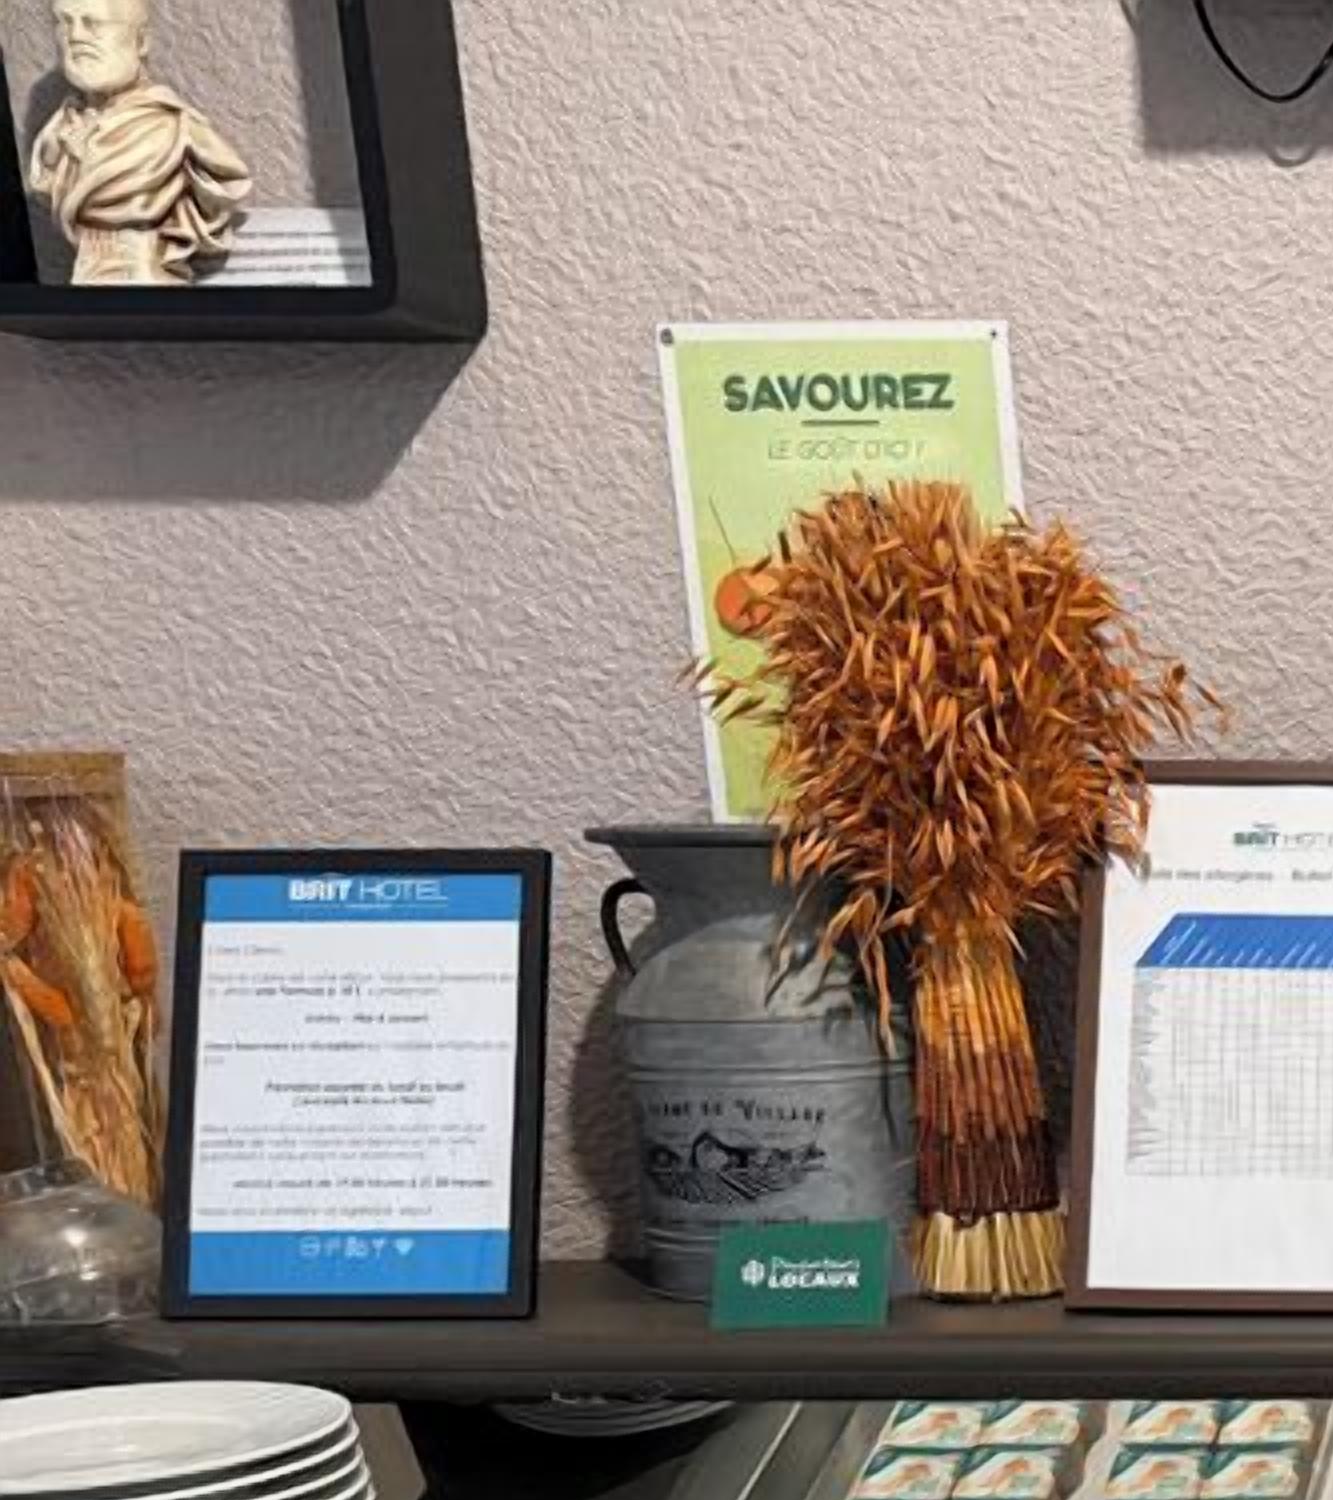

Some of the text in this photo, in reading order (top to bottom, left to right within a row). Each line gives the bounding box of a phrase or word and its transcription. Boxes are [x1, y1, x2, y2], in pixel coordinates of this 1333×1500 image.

[723, 373, 956, 412] SAVOUREZ
[360, 880, 449, 901] HOTEL
[767, 1269, 861, 1289] LOCAUX
